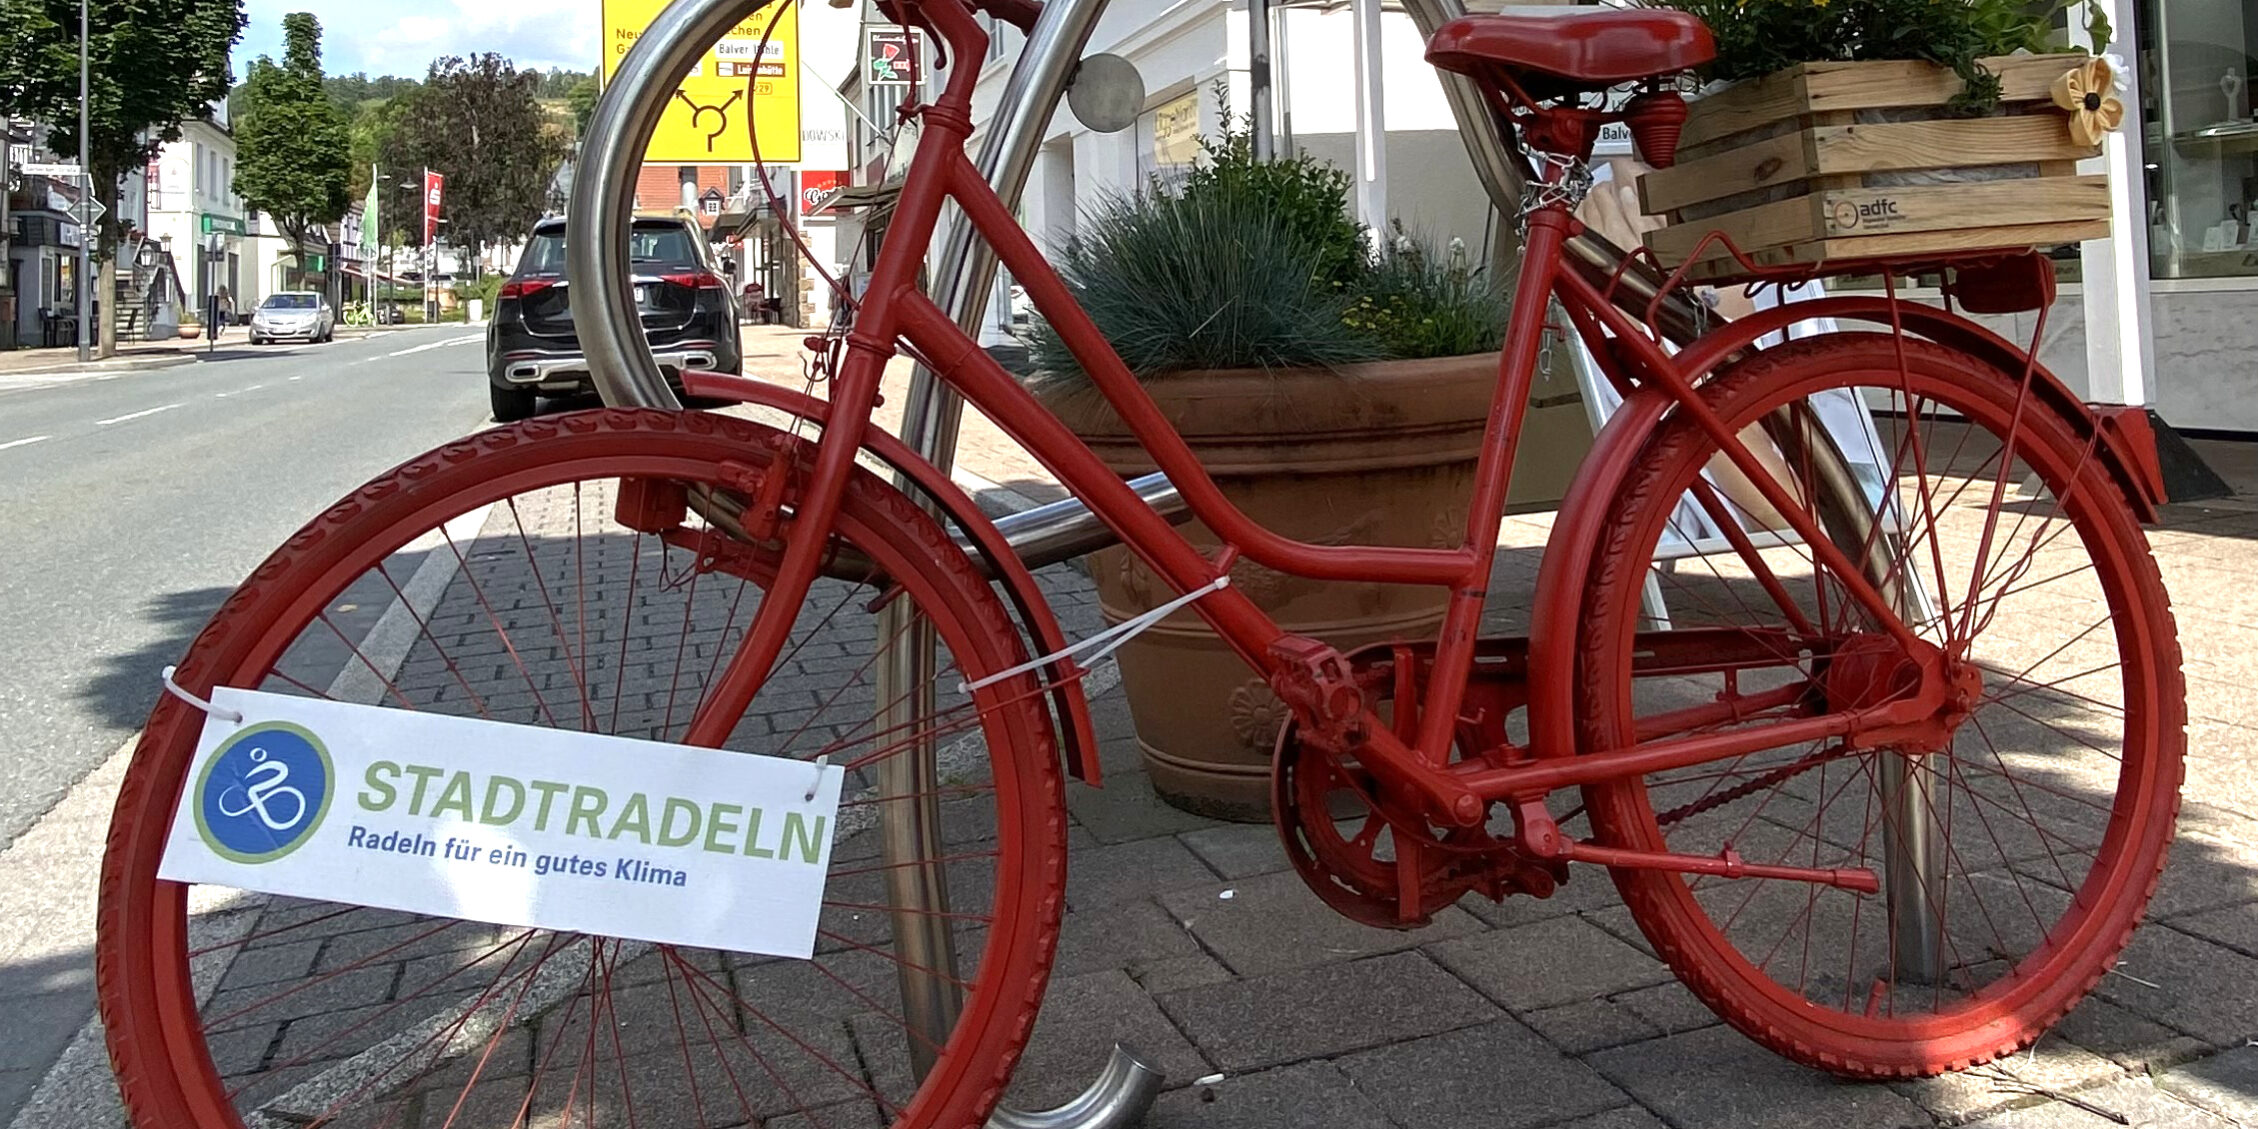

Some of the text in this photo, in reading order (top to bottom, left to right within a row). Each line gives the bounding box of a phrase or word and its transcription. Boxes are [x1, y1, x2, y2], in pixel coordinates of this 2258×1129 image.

[728, 26, 761, 36] chen
[719, 43, 779, 55] Balver Hhle
[1860, 199, 1898, 216] adfc
[357, 759, 826, 865] STADTRADELN
[348, 825, 688, 887] Radeln für ein gutes Klima
